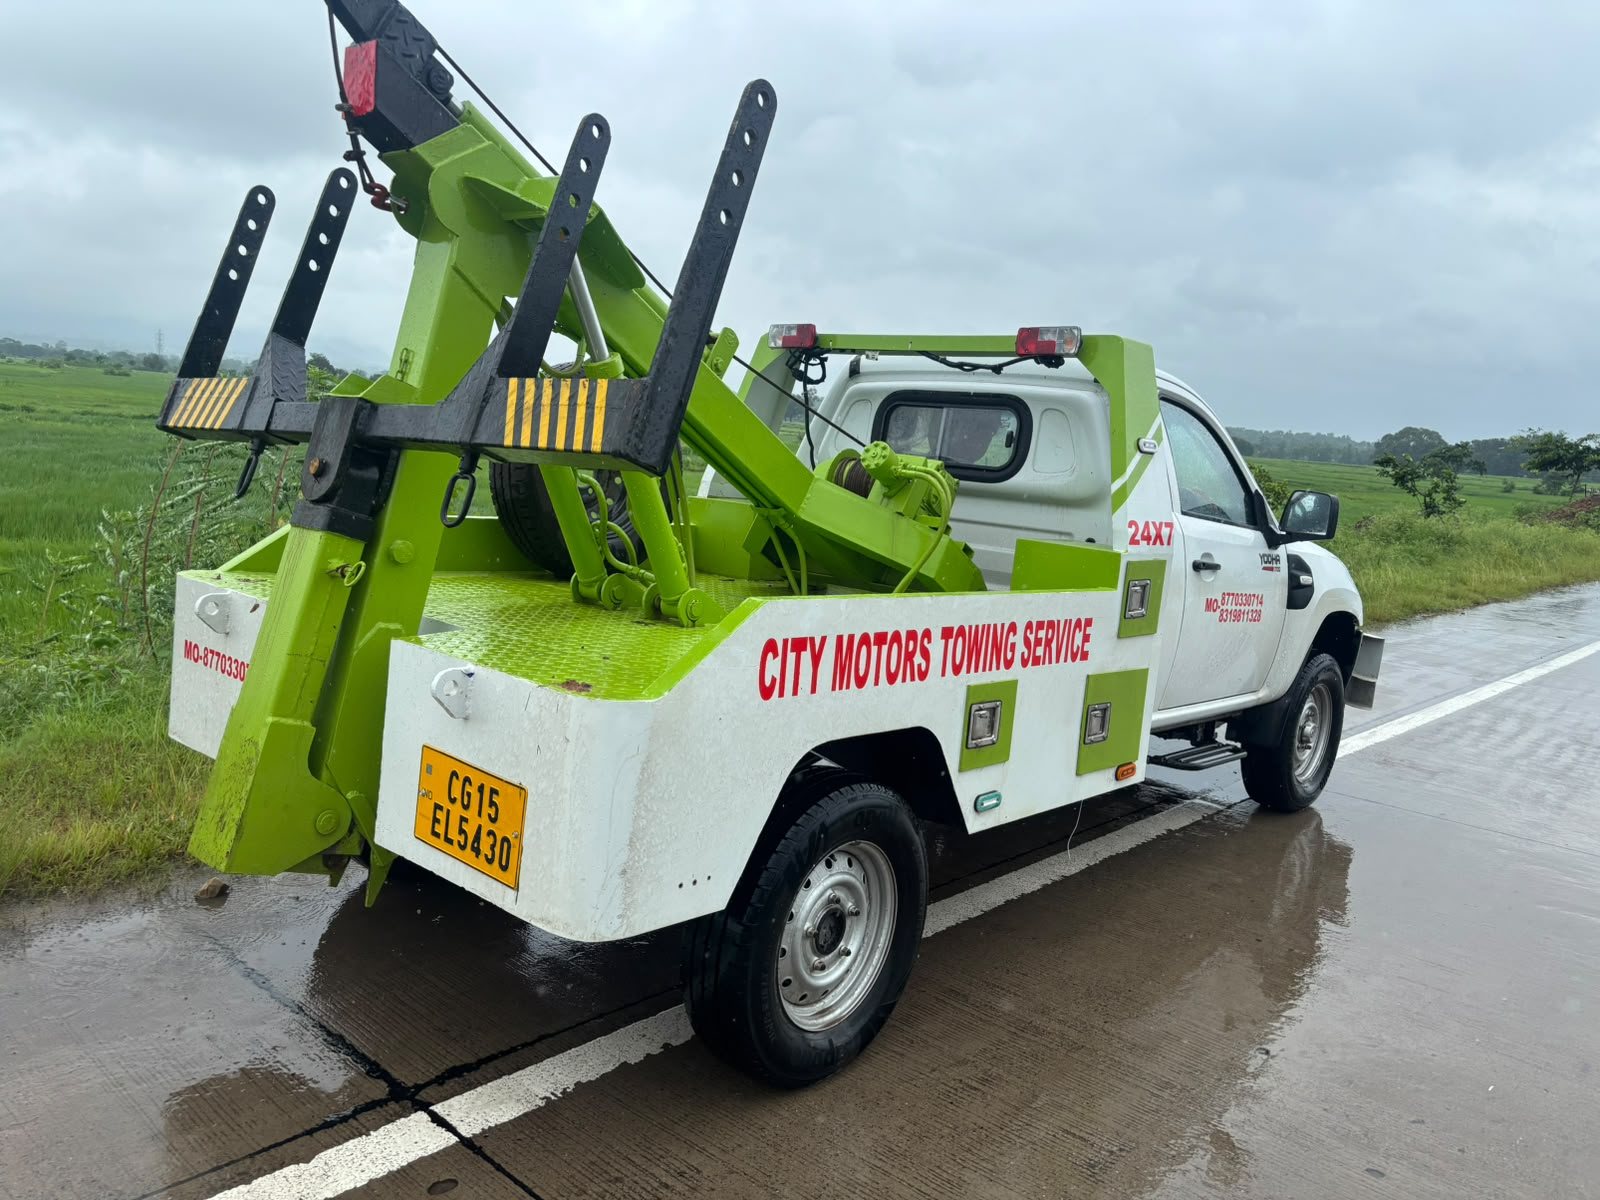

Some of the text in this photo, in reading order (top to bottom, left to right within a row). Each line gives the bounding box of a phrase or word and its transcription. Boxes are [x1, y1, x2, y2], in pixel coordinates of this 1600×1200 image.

[1127, 519, 1174, 546] 24X7
[1218, 608, 1262, 623] 8319811328
[1220, 591, 1264, 607] 8770330714
[758, 617, 1093, 701] CITY MOTORS TOWING SERVICE
[447, 769, 500, 824] CG15
[431, 802, 512, 872] EL5430
